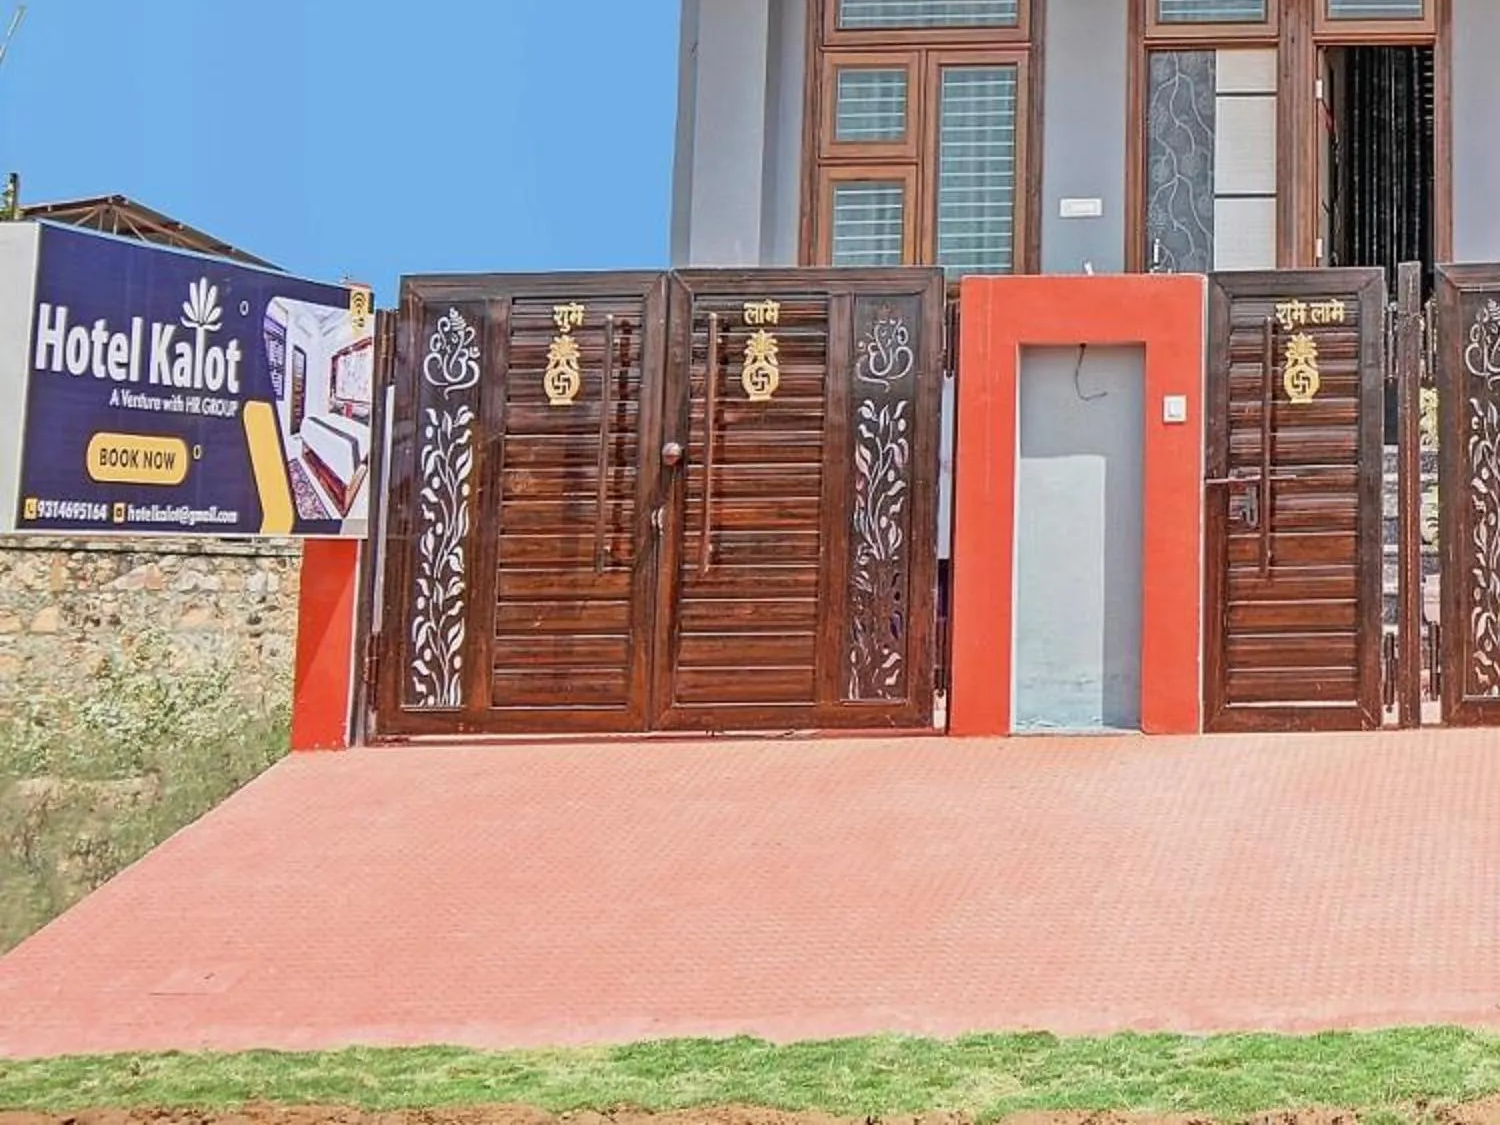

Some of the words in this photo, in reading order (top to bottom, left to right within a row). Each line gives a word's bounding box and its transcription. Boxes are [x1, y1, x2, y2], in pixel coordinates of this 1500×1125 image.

[35, 302, 143, 382] Hotel
[149, 322, 241, 394] Kalot
[109, 388, 119, 407] A
[121, 389, 161, 411] Venture
[163, 394, 184, 412] with
[202, 397, 239, 417] GROUP
[100, 448, 139, 468] BOOK
[143, 450, 176, 469] NOW
